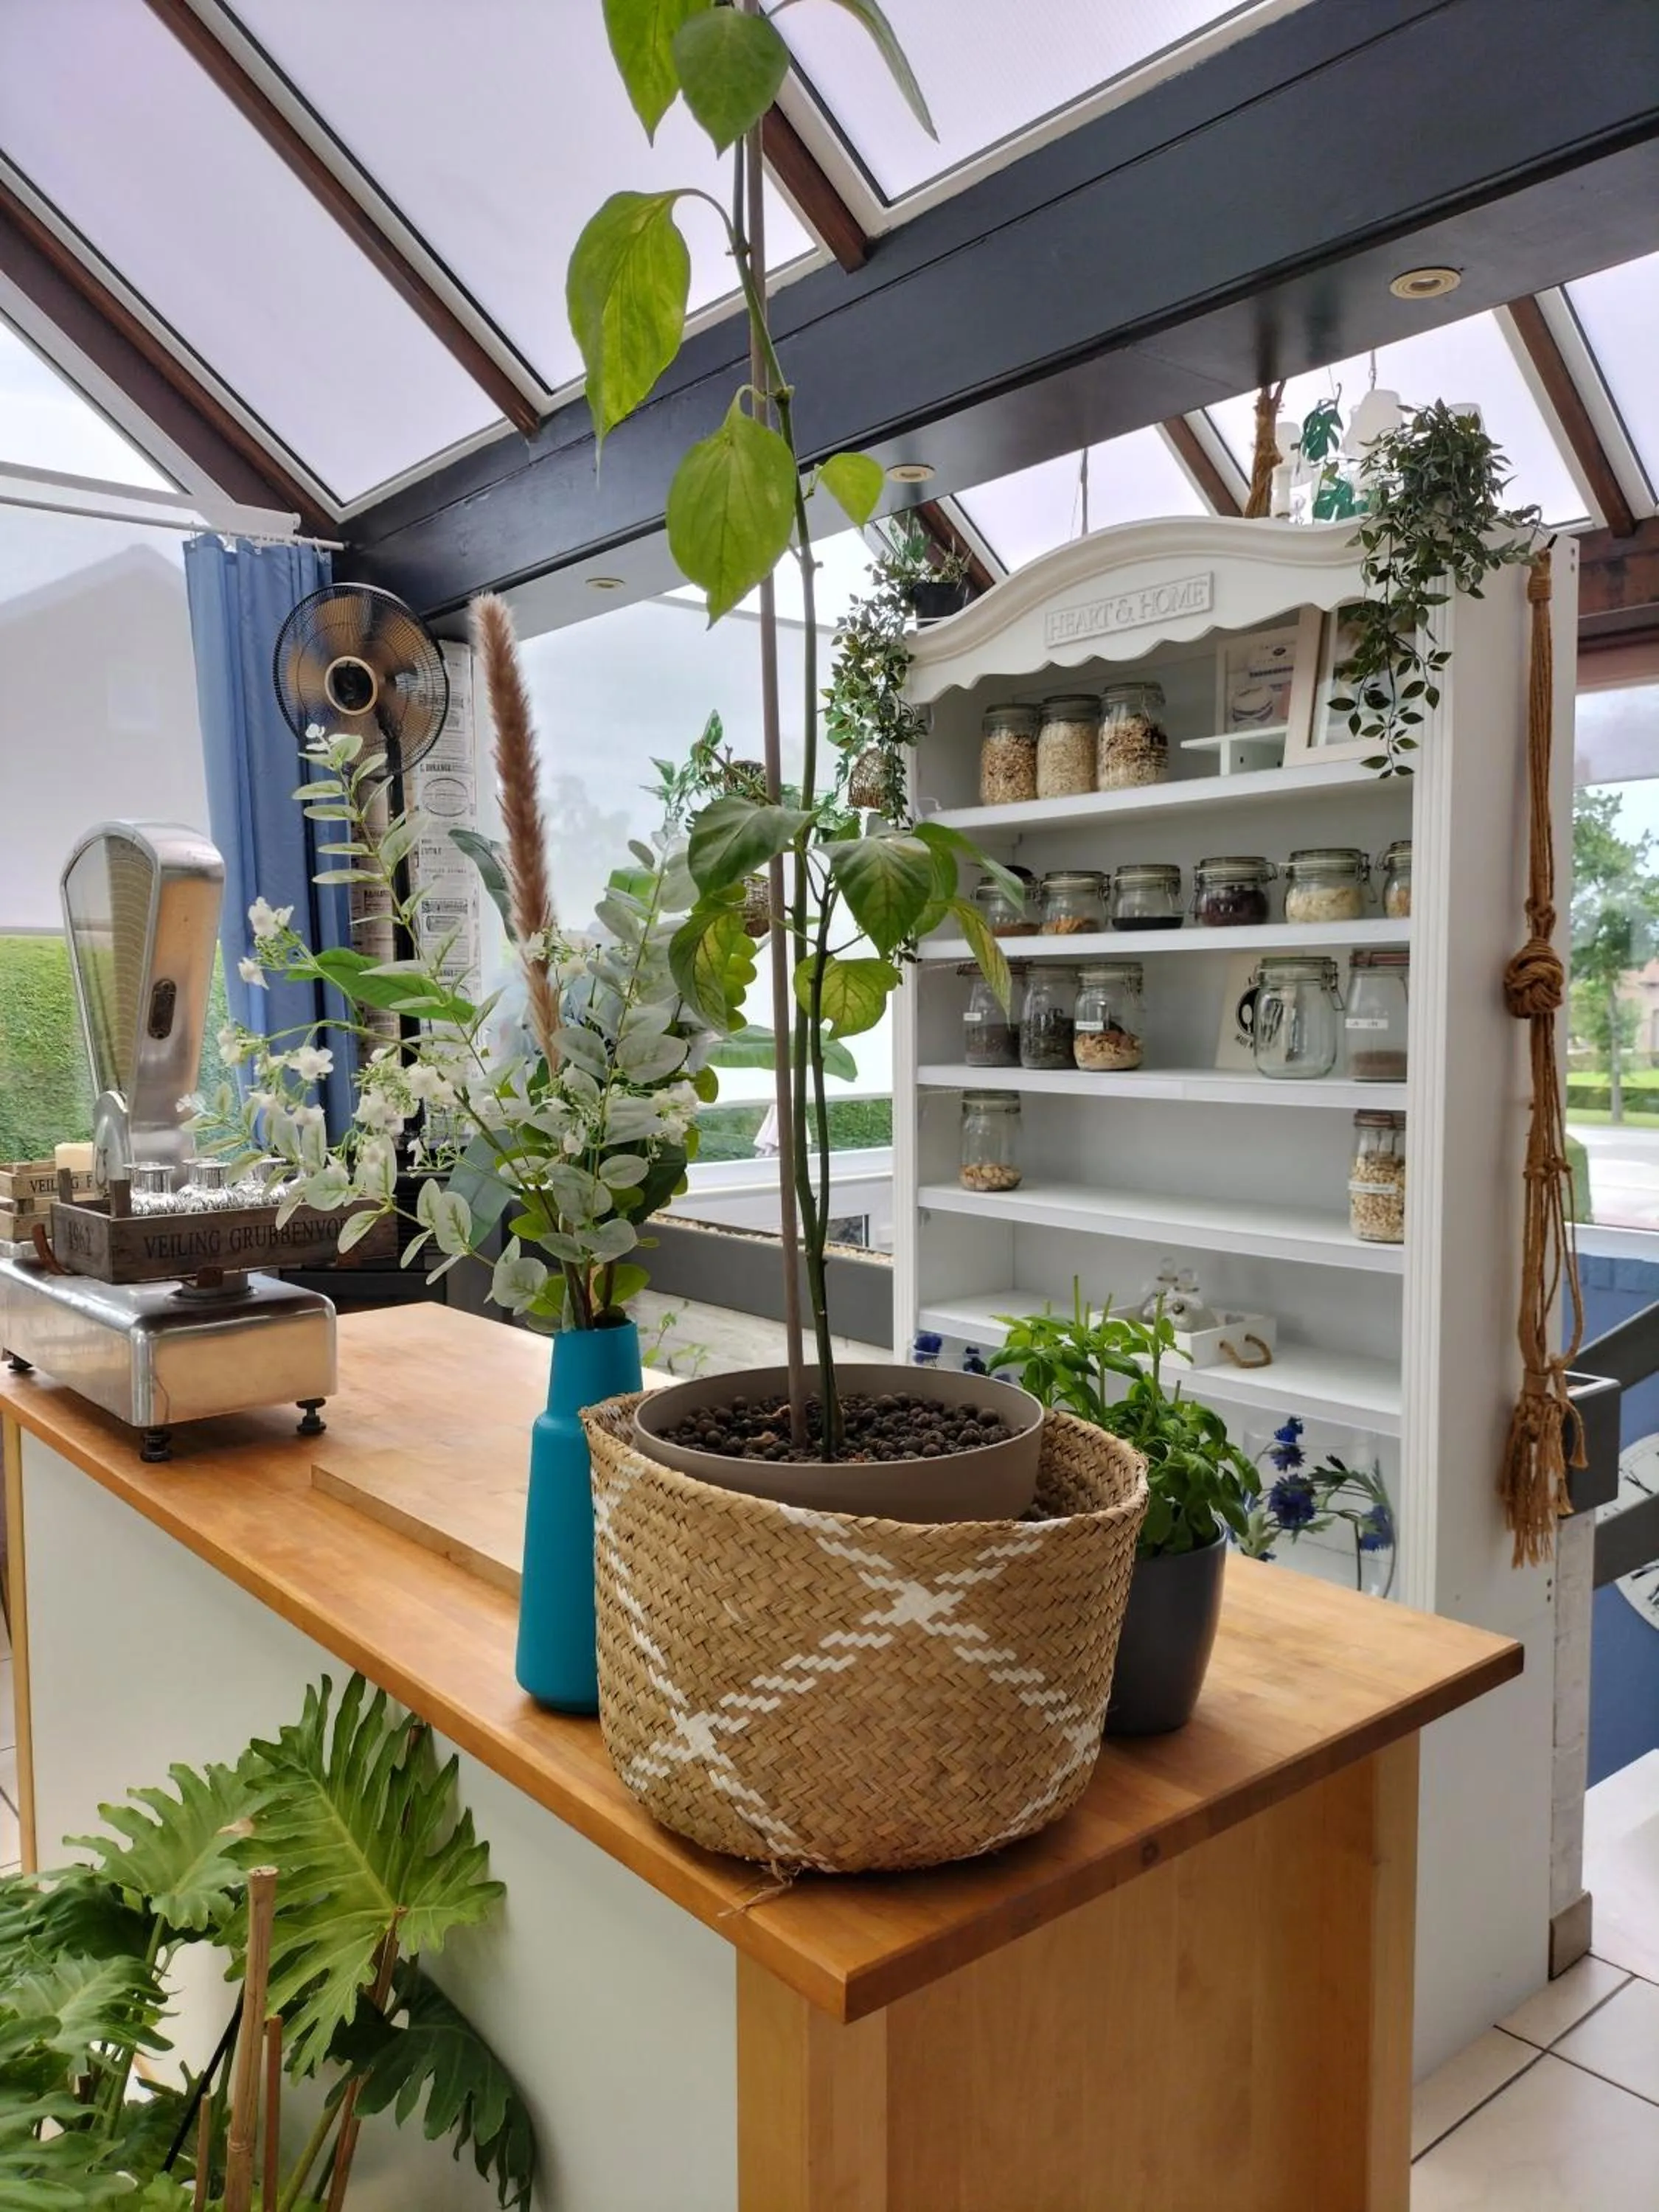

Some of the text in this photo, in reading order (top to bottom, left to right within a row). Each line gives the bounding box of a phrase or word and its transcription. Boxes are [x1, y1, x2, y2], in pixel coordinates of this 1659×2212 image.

[1048, 580, 1208, 640] HEART & HOME
[29, 1175, 79, 1193] VEILG
[143, 1229, 221, 1259] VEILING
